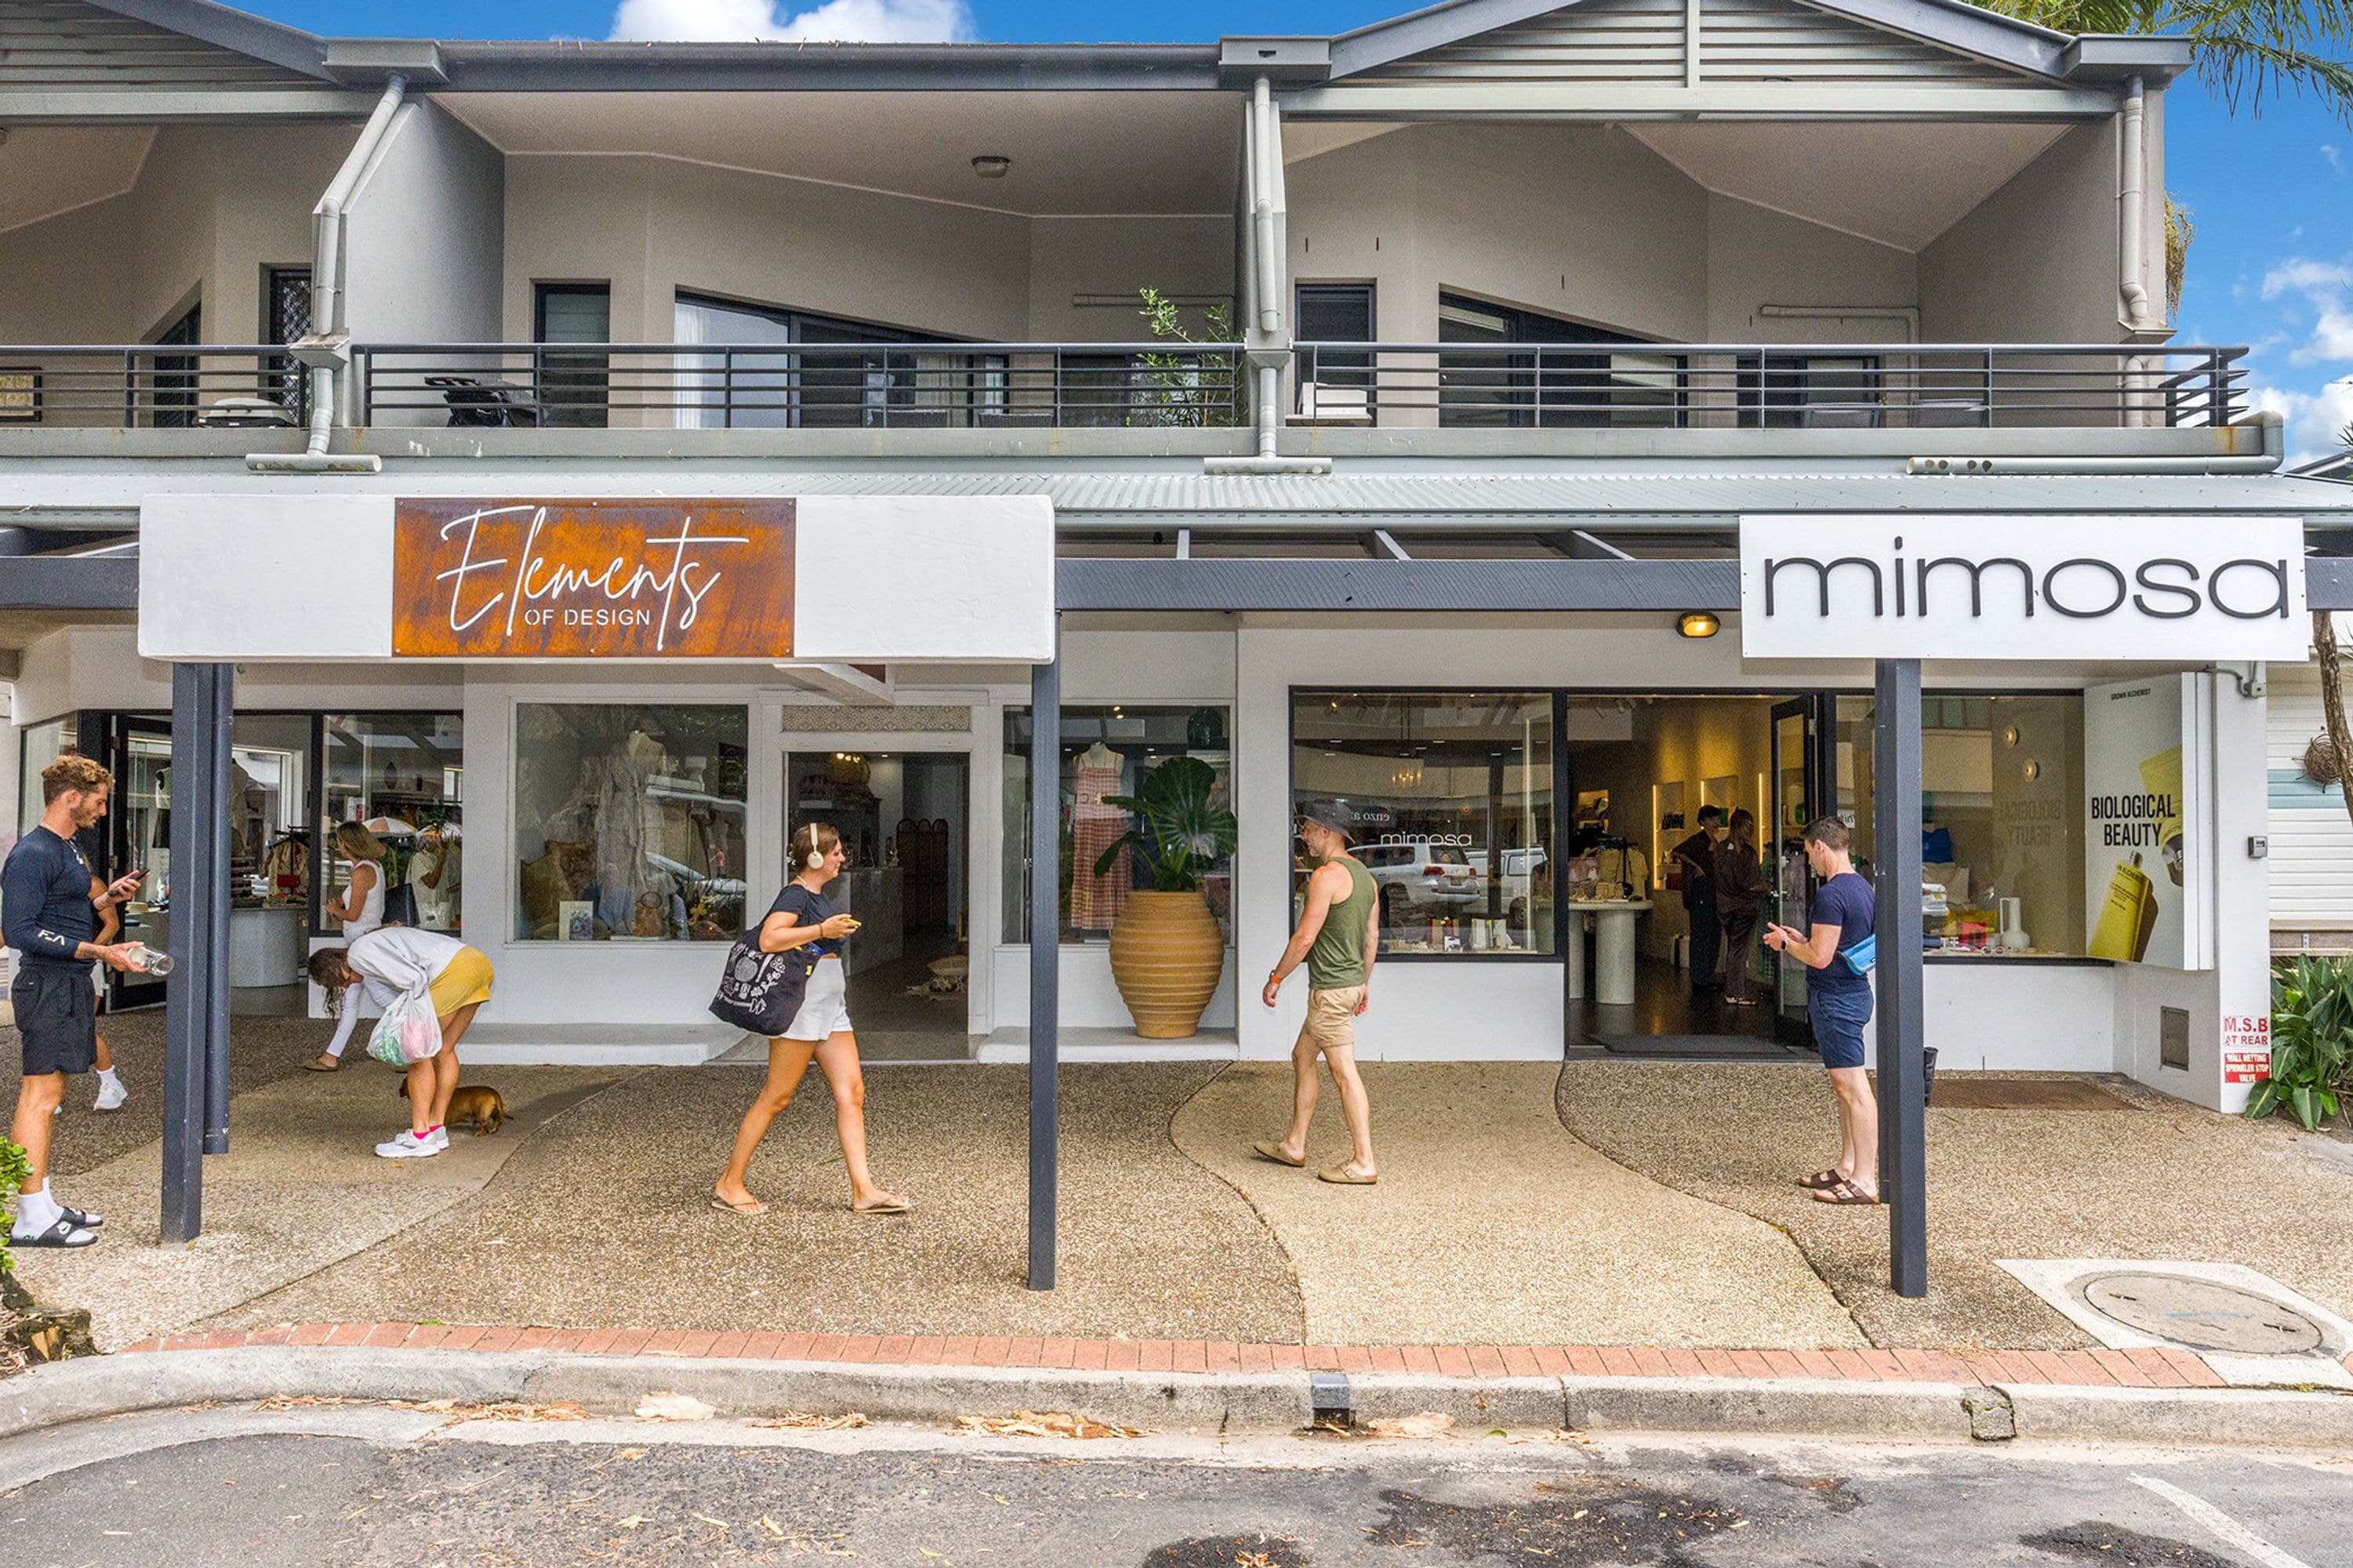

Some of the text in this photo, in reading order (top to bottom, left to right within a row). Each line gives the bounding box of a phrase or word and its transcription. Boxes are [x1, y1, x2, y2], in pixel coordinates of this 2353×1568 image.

[436, 505, 750, 651] Elements
[1764, 535, 2289, 619] mimosa
[524, 608, 651, 626] OF DESIGN
[2091, 793, 2176, 819] BIOLOGICAL
[1380, 831, 1472, 846] mimosa
[2104, 822, 2162, 847] BEAUTY
[2224, 1018, 2268, 1033] M.S.B
[2224, 1035, 2268, 1045] AT REAR
